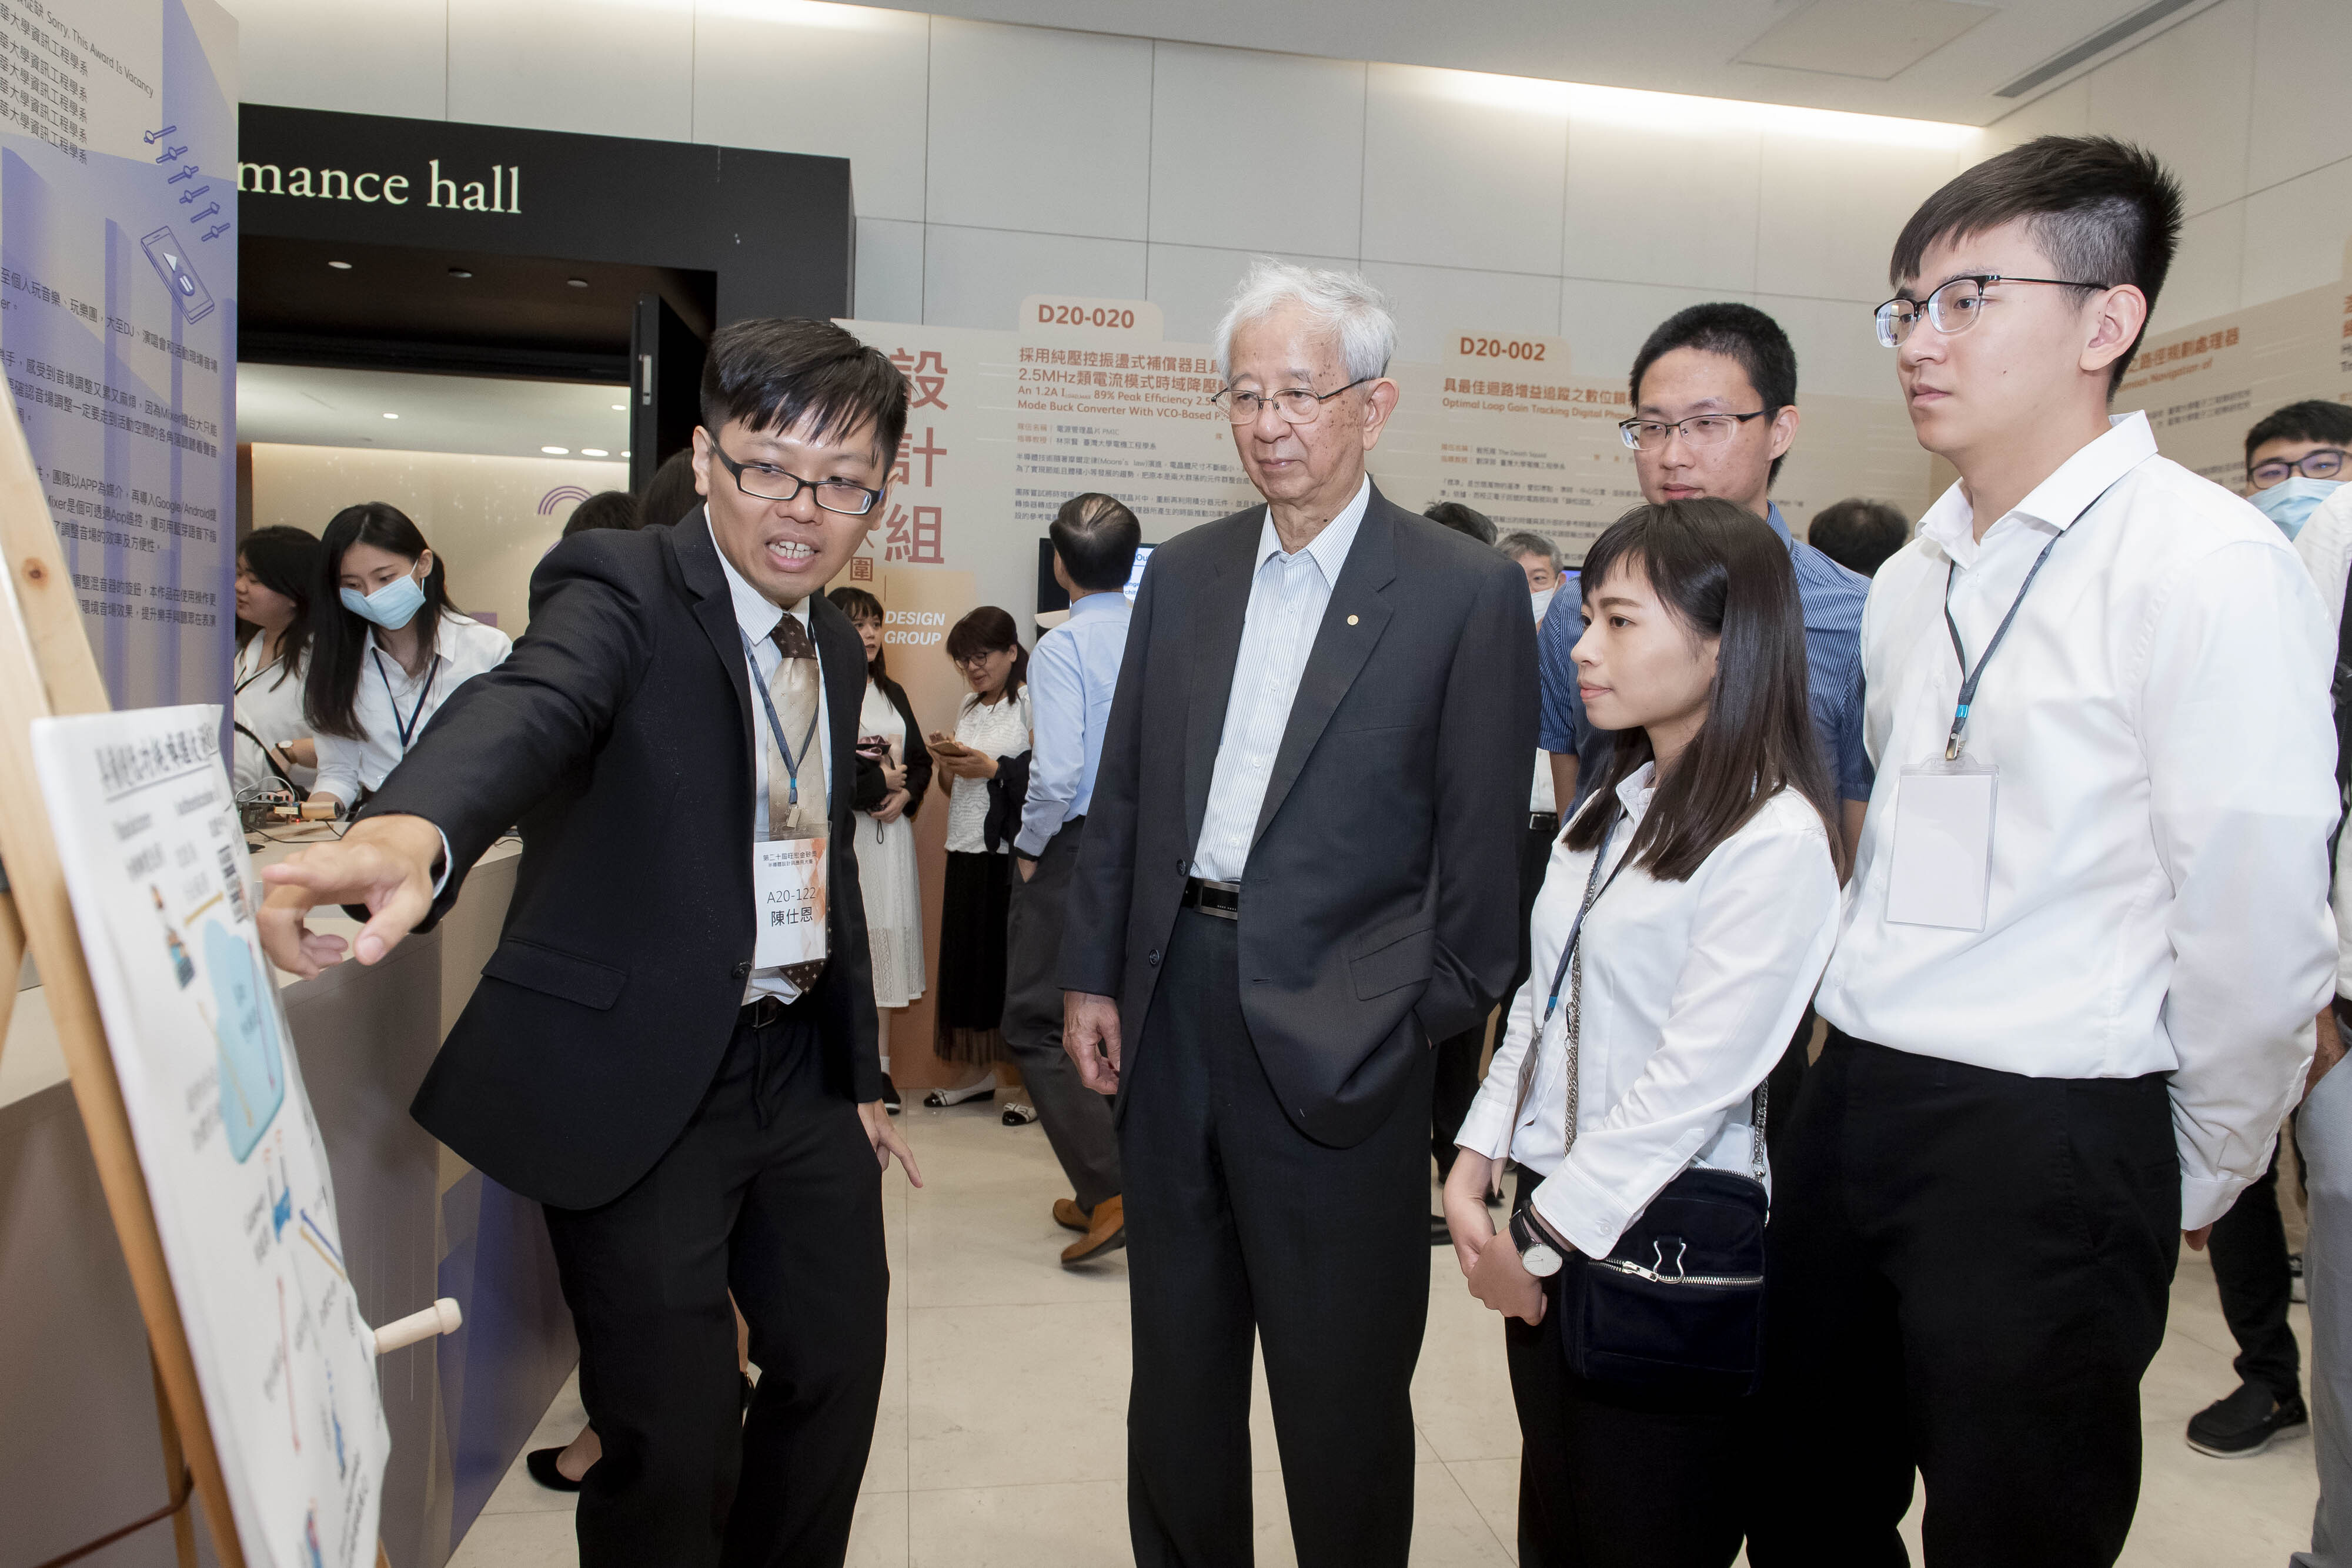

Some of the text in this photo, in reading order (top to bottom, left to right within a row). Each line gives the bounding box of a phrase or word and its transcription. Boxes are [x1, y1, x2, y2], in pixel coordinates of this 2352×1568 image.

[72, 28, 89, 50] This
[90, 42, 114, 69] Award
[116, 60, 123, 75] Is
[124, 66, 153, 98] Vacancy
[238, 159, 522, 213] mance hall
[1038, 304, 1134, 329] D20-020
[1460, 336, 1546, 361] D20-002
[1018, 385, 1032, 395] An
[1035, 386, 1058, 397] 1.2A
[1094, 390, 1115, 400] 89%
[1118, 392, 1141, 402] Peak
[1145, 393, 1193, 407] Efficiency
[1018, 399, 1047, 410] Mode
[1050, 401, 1074, 412] Buck
[1077, 403, 1127, 414] Converter
[1128, 406, 1154, 416] With
[1157, 408, 1211, 420] VCO-Based
[1442, 397, 1480, 409] Optimal
[1482, 401, 1505, 413] Loop
[1507, 403, 1529, 412] Gain
[1531, 404, 1569, 418] Tracking
[1571, 407, 1603, 419] Digital
[884, 611, 946, 626] DESIGN
[884, 630, 941, 646] GROUP
[767, 887, 816, 904] A20-122
[771, 907, 813, 927] 陳仕恩
